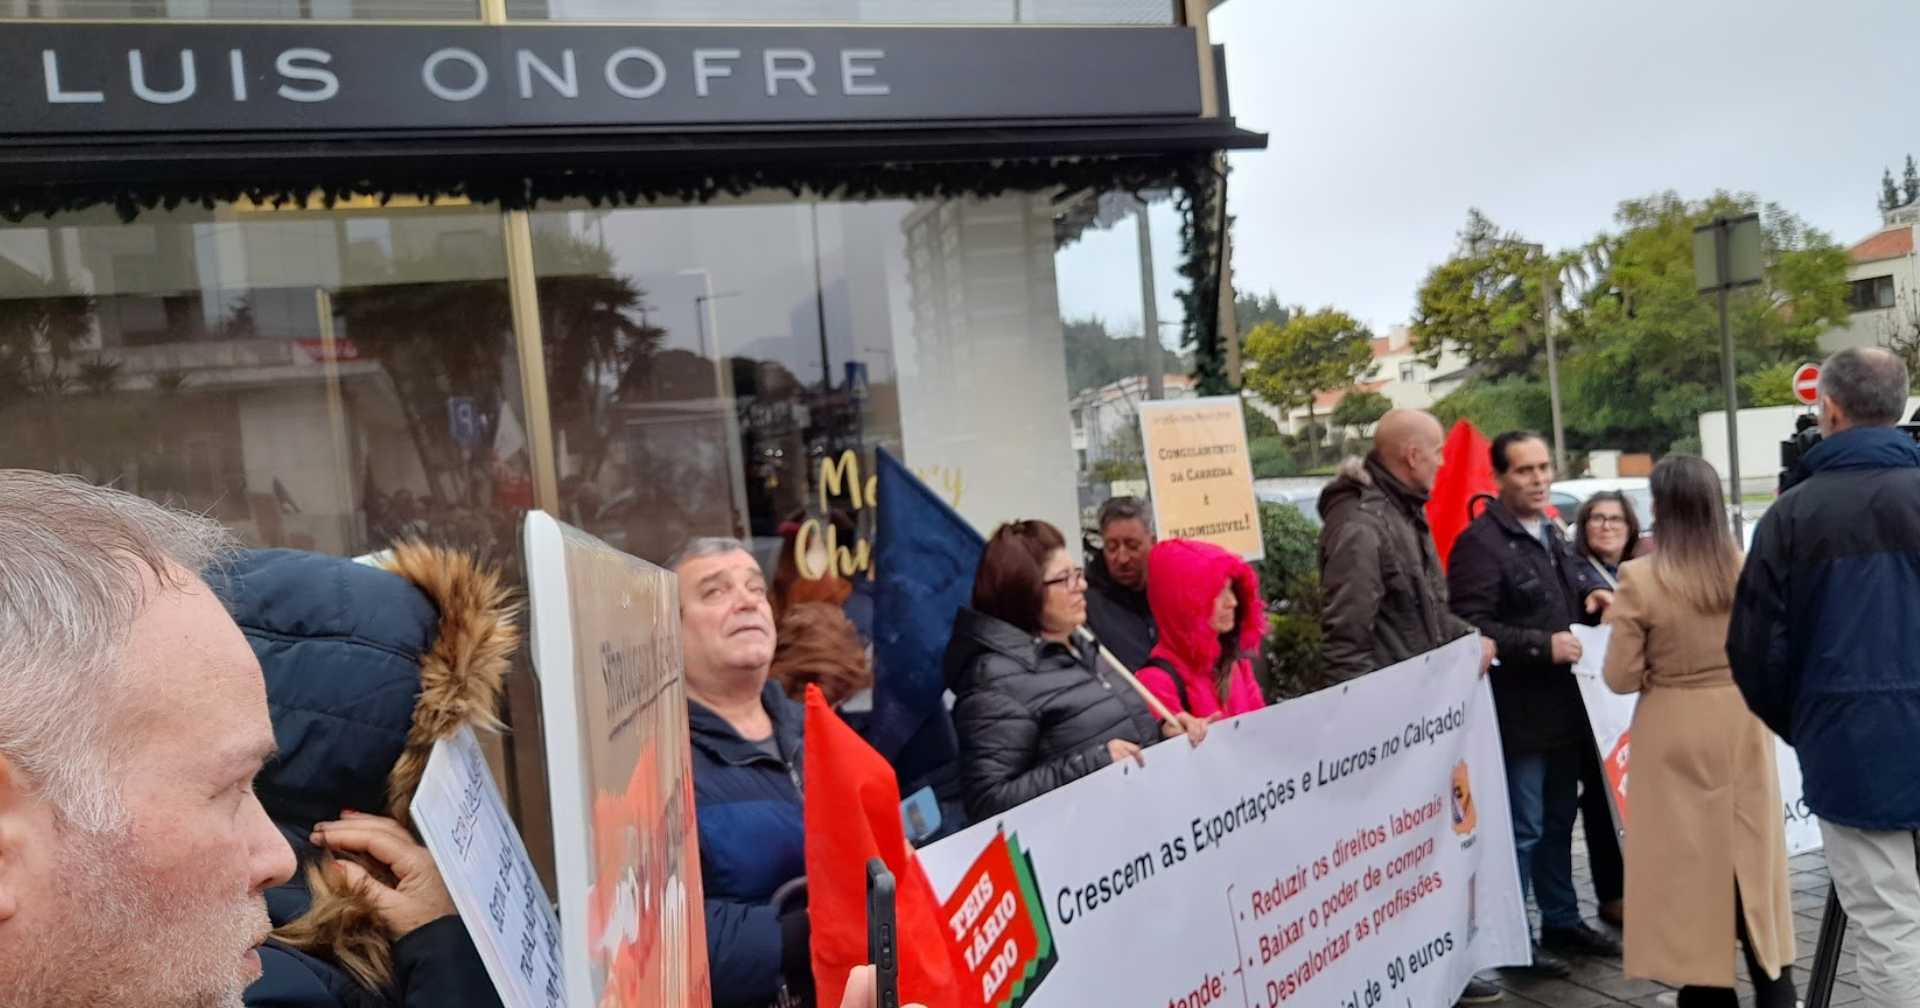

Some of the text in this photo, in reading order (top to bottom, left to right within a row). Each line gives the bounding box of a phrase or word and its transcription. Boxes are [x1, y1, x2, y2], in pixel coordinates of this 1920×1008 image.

[43, 46, 892, 104] LUIS ONOFRE
[1057, 852, 1155, 925] Crescem
[1161, 836, 1187, 869] as
[1191, 775, 1296, 852] Exportações
[1302, 771, 1311, 793] e
[1318, 747, 1377, 787] Lucros
[1381, 734, 1399, 761] no
[1252, 794, 1443, 920] Reduzir os direitos laborais
[1258, 916, 1304, 965] Baixar
[1310, 910, 1318, 929] o
[1322, 879, 1359, 927] poder
[1363, 864, 1382, 891] de
[1386, 837, 1435, 881] compra
[1265, 871, 1443, 1008] Desvalorizar as profissões
[1364, 978, 1381, 1008] de
[1386, 956, 1405, 989] 90
[1408, 931, 1454, 974] euros
